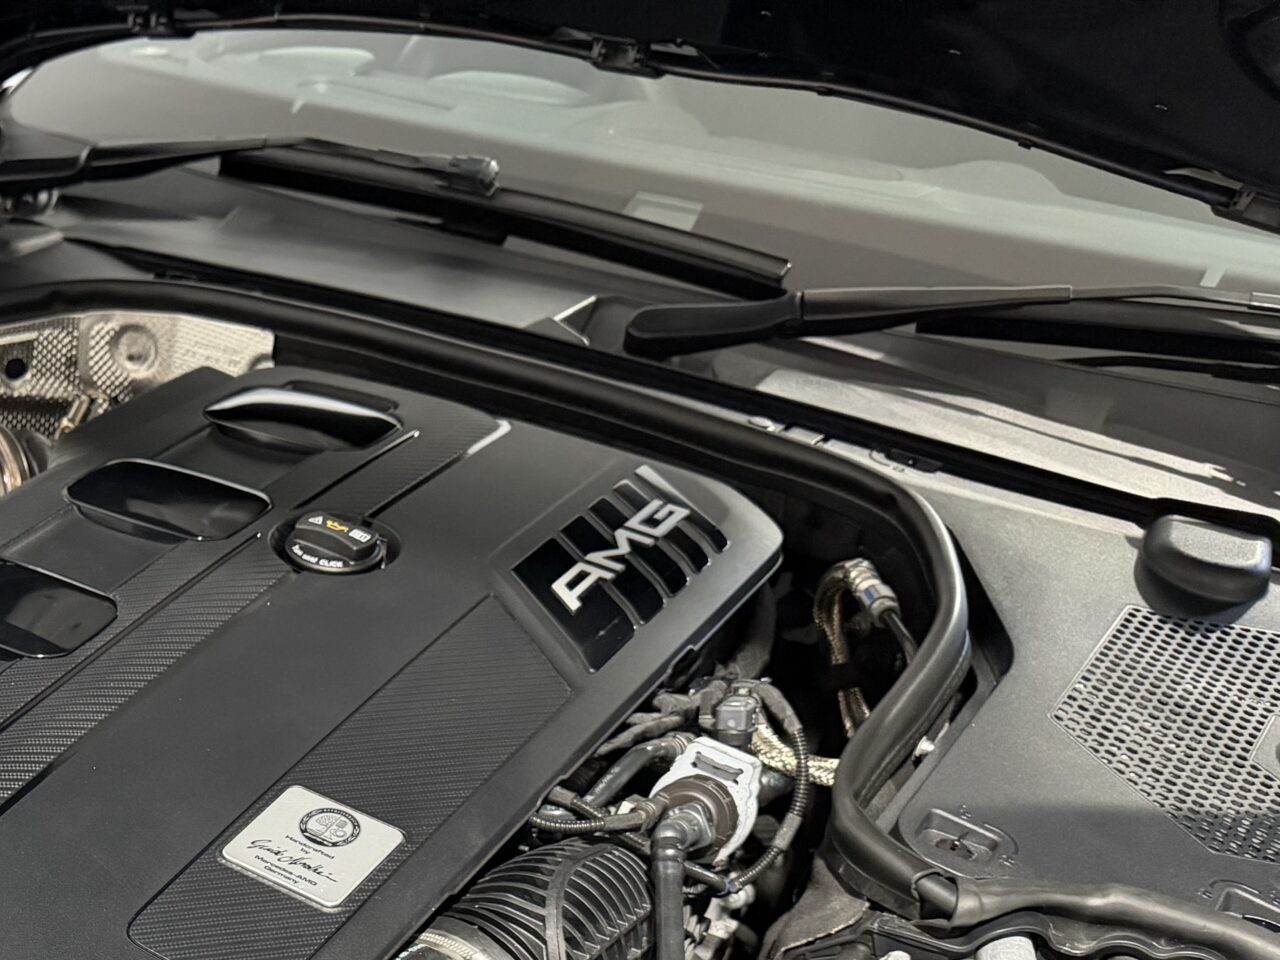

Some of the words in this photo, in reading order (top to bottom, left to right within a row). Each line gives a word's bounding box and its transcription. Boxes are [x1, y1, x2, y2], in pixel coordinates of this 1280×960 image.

[319, 558, 344, 568] CLICK
[551, 499, 691, 615] AMG
[285, 835, 335, 859] Handcrafted
[254, 855, 318, 886] Mercedes-AMG
[264, 866, 298, 884] Germany
